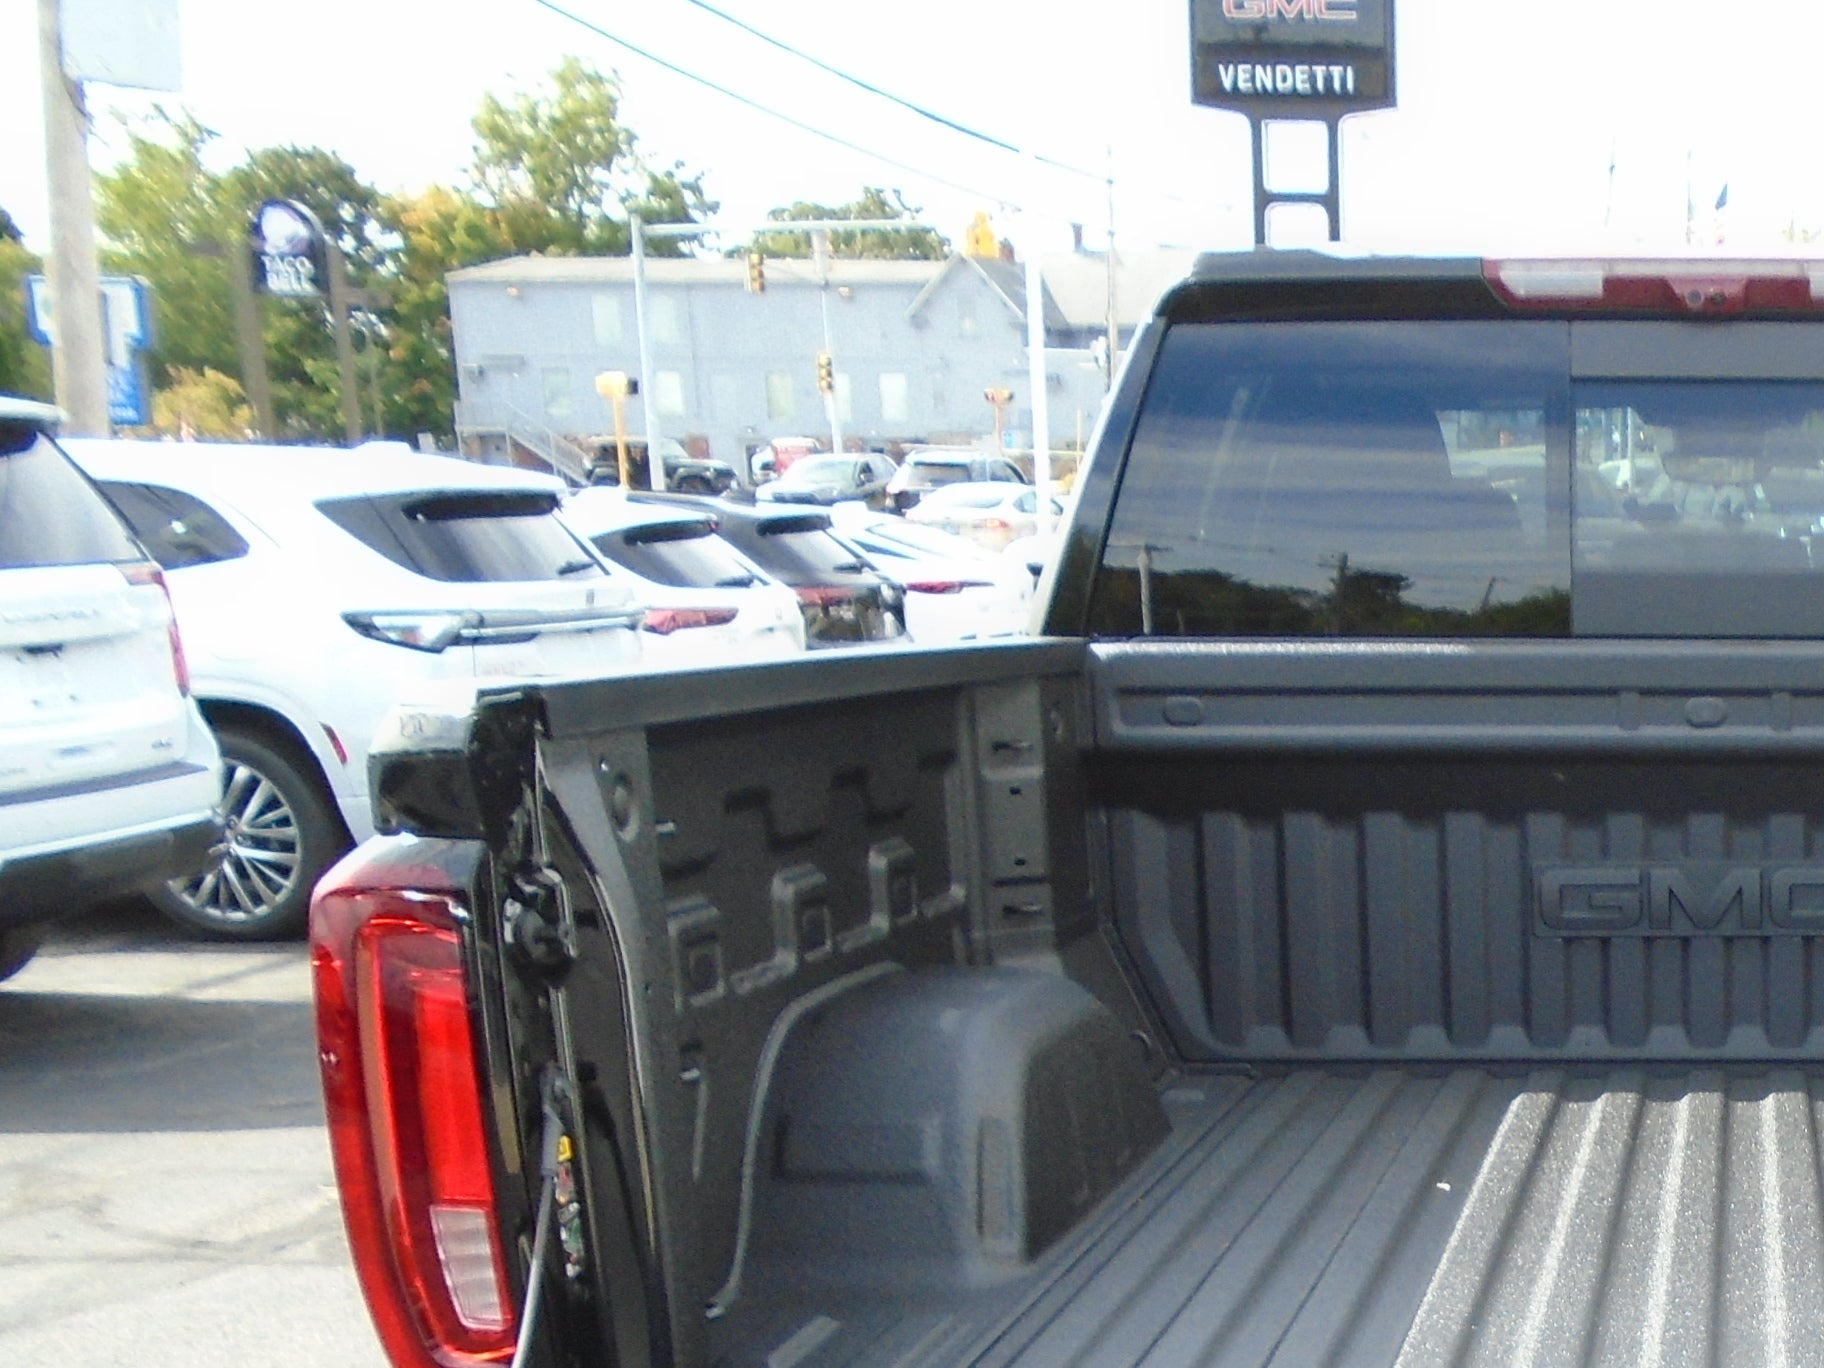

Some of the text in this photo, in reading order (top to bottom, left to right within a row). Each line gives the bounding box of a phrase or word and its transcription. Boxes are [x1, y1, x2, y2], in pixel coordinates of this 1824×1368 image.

[1222, 0, 1358, 20] GMC
[1218, 62, 1356, 95] VENDETTI
[261, 255, 315, 278] TACO
